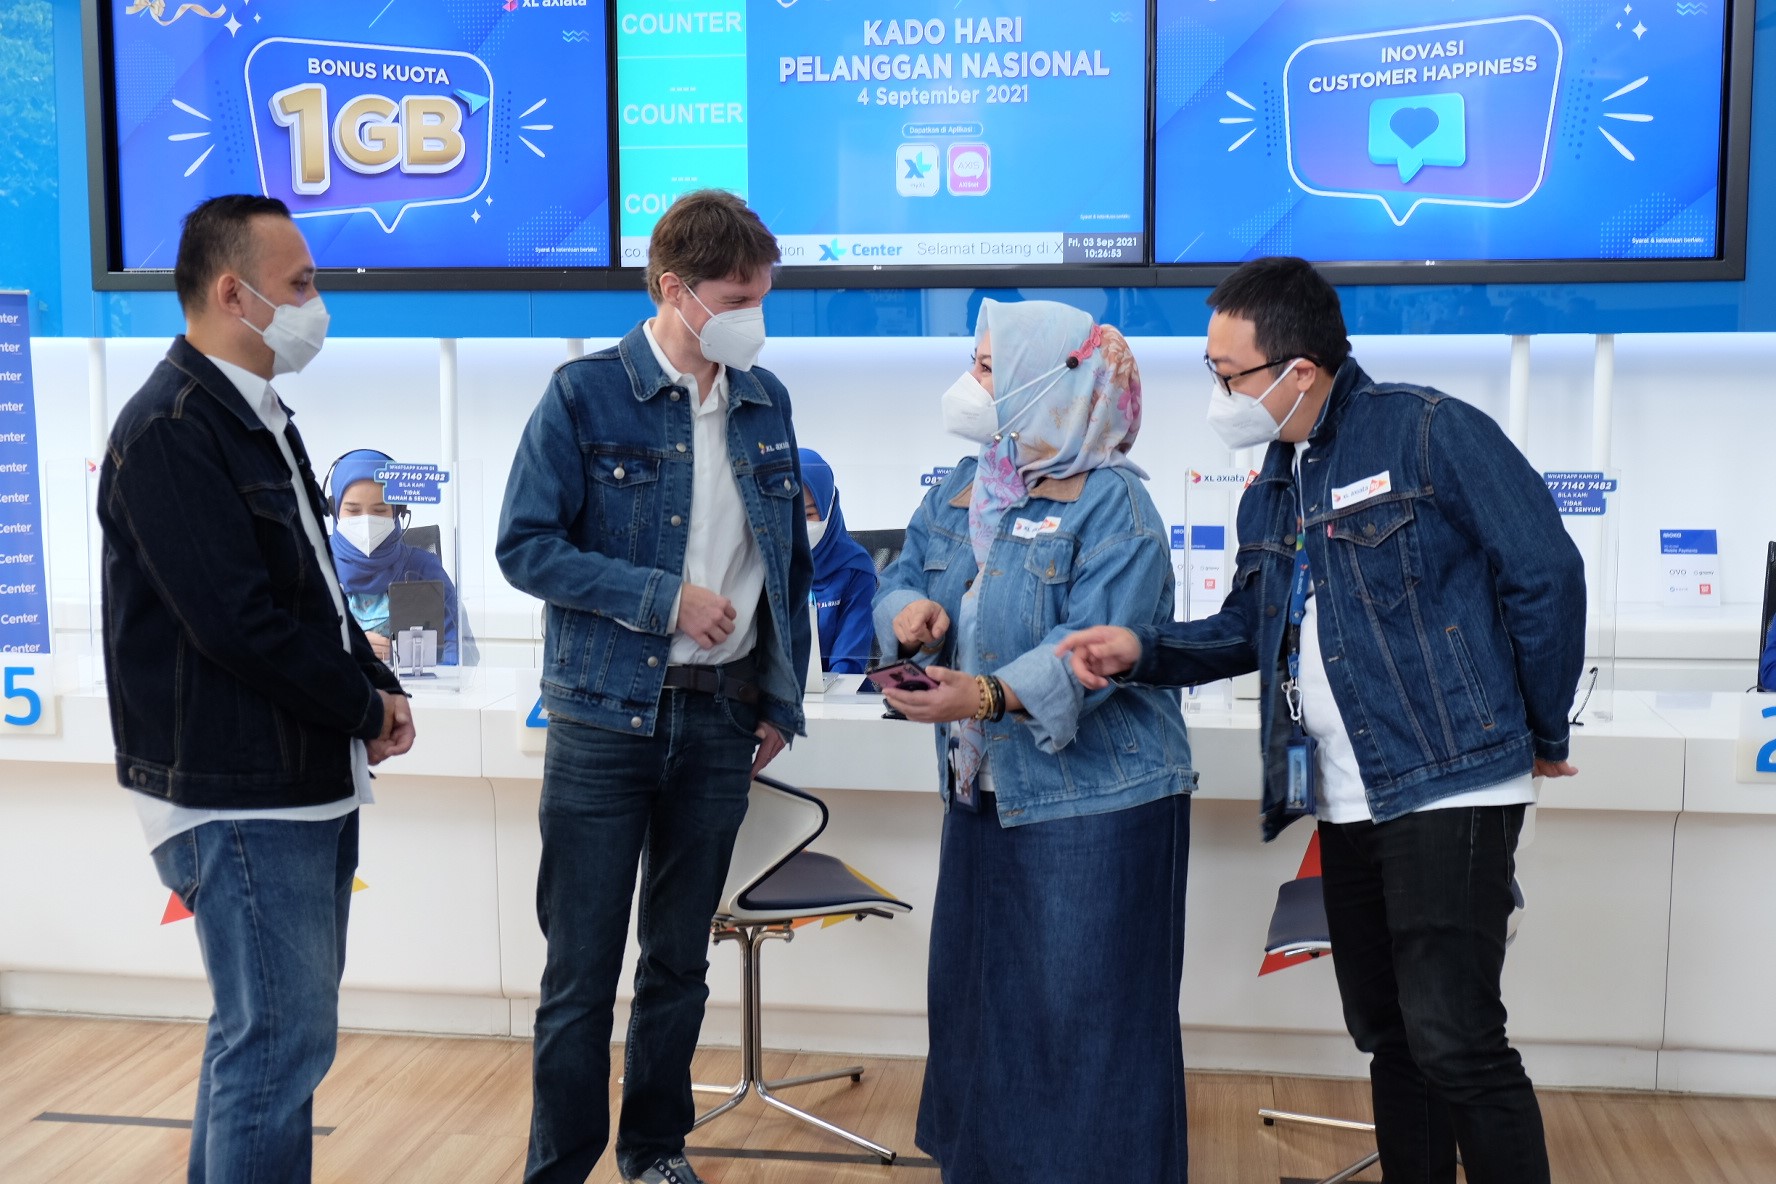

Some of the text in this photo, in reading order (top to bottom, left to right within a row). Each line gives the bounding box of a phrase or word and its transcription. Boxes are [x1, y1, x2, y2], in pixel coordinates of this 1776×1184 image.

[622, 12, 743, 34] COUNTER
[863, 16, 1022, 46] KADO HARI
[1381, 40, 1464, 63] INOVASI
[307, 57, 450, 85] BONUS KUOTA
[779, 50, 1110, 82] PELANGGAN NASIONAL
[1308, 55, 1537, 93] CUSTOMER HAPPINESS
[857, 84, 1028, 108] 4 September 2021
[623, 102, 744, 124] COUNTER
[270, 82, 466, 195] 1GB
[852, 243, 903, 256] Center
[917, 242, 975, 255] Selamat
[980, 242, 1031, 258] Datang
[1037, 242, 1049, 254] di
[1083, 238, 1095, 247] 03
[1096, 237, 1114, 248] Sep
[1116, 237, 1137, 247] 2021
[1084, 249, 1122, 258] 10:26:53
[0, 462, 27, 472] enter
[378, 471, 400, 480] 0877
[401, 472, 422, 480] 7140
[1203, 474, 1245, 483] XL axiata
[1561, 481, 1585, 490] 7140
[0, 583, 36, 594] Center
[1, 614, 38, 624] Center
[3, 643, 40, 653] Center
[4, 667, 41, 726] 5
